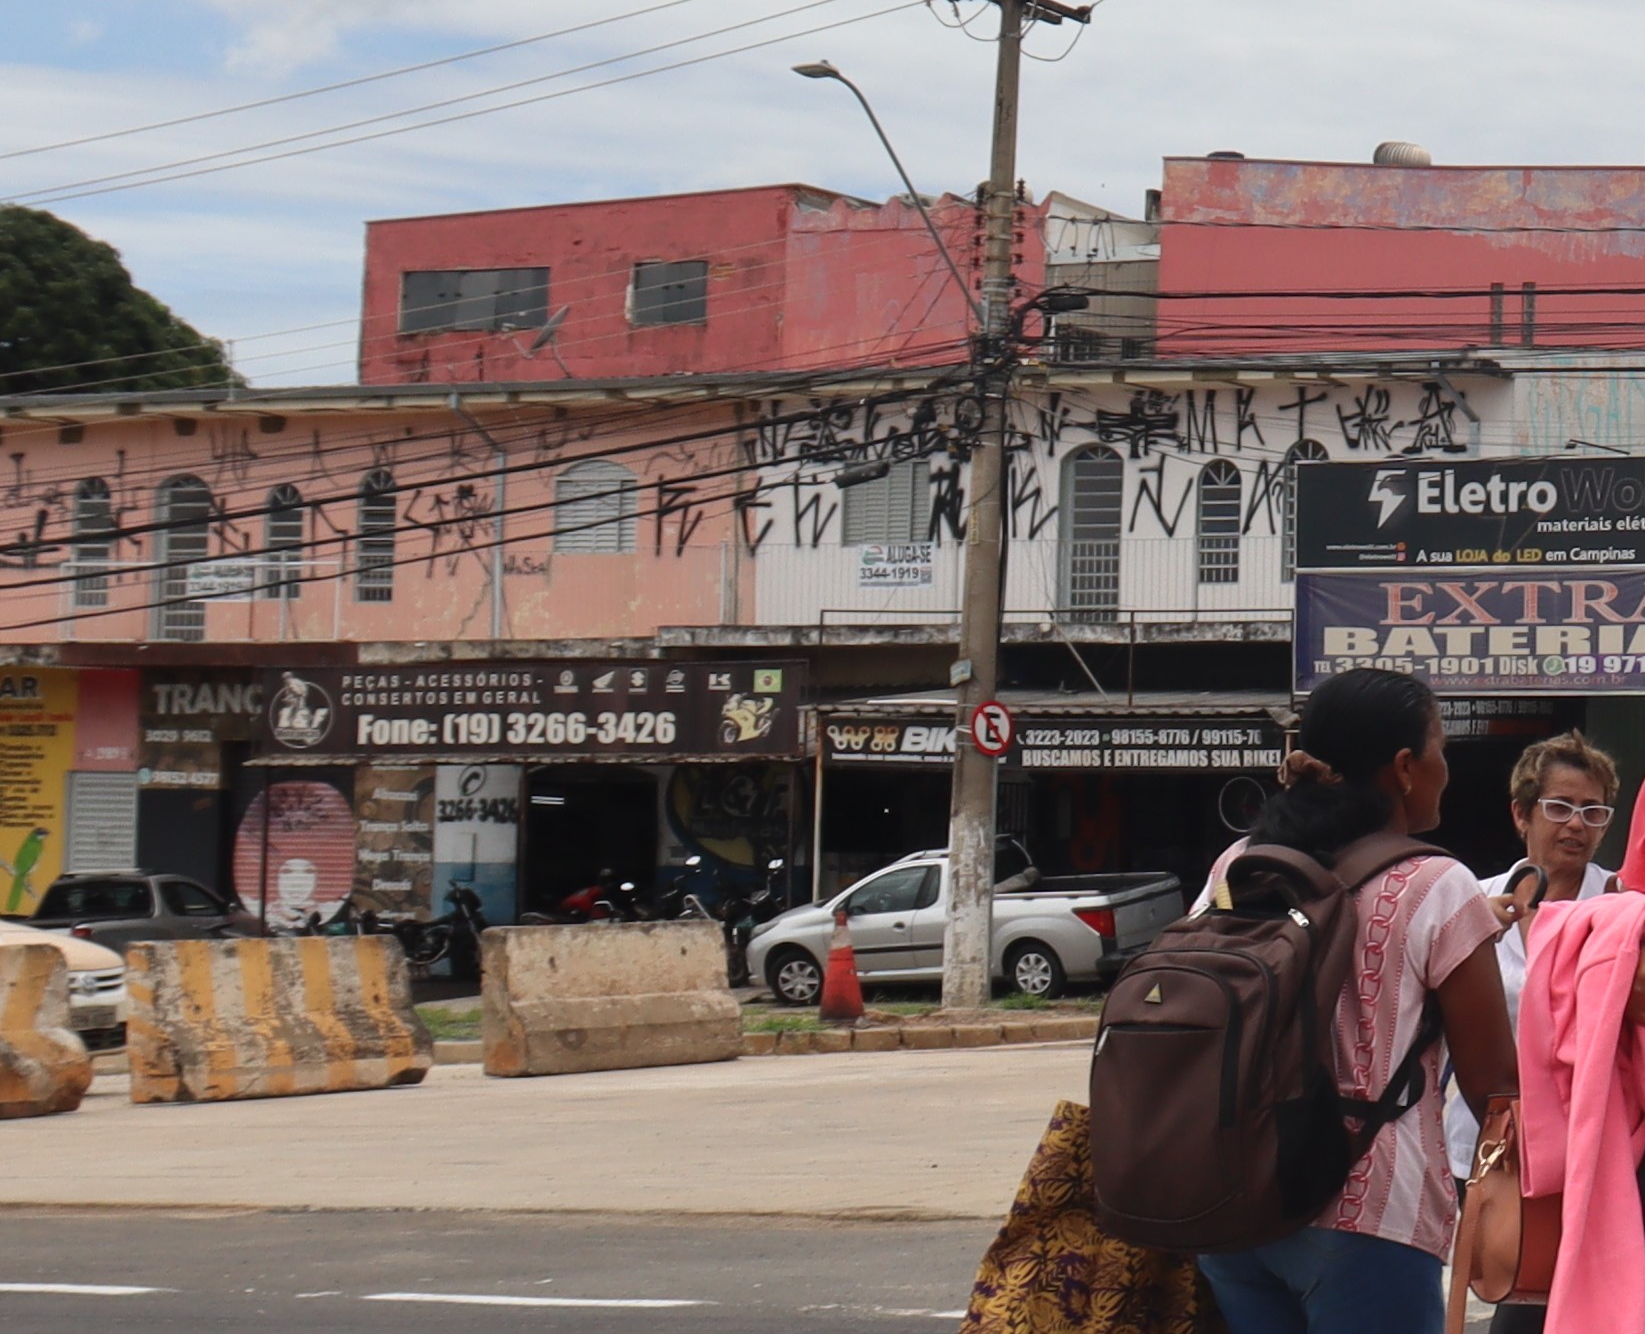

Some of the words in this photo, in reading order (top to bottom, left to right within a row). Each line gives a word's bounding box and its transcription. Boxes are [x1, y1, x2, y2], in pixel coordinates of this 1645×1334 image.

[1538, 517, 1611, 532] materiais
[1416, 550, 1426, 562] A
[1430, 552, 1452, 562] sua
[1456, 549, 1488, 562] LOJA
[1492, 549, 1511, 562] do
[1517, 548, 1542, 561] LED
[1546, 550, 1567, 561] em
[1570, 546, 1635, 563] Campinas
[1314, 660, 1331, 673] TEL
[1499, 655, 1538, 675] Disk
[1565, 655, 1596, 674] 19
[342, 675, 399, 690] PEÇAS
[415, 672, 532, 688] ACESSÓRIOS
[1430, 675, 1627, 686] www.extrabaterias.com.br
[341, 691, 448, 705] CONSERTOS
[453, 691, 477, 705] EM
[482, 690, 541, 704] GERAL
[357, 714, 437, 745] Fone:
[442, 713, 501, 744] (19)
[507, 711, 676, 744] 3266-3426
[1026, 729, 1099, 745] 3223-2023
[1112, 728, 1190, 745] 98155-8776
[1022, 750, 1100, 766] BUSCAMOS
[1104, 750, 1112, 766] E
[1114, 749, 1208, 766] ENTREGAMOS
[1211, 749, 1241, 766] SUA
[1244, 749, 1281, 766] BIKE!
[438, 798, 518, 823] 3266-3426
